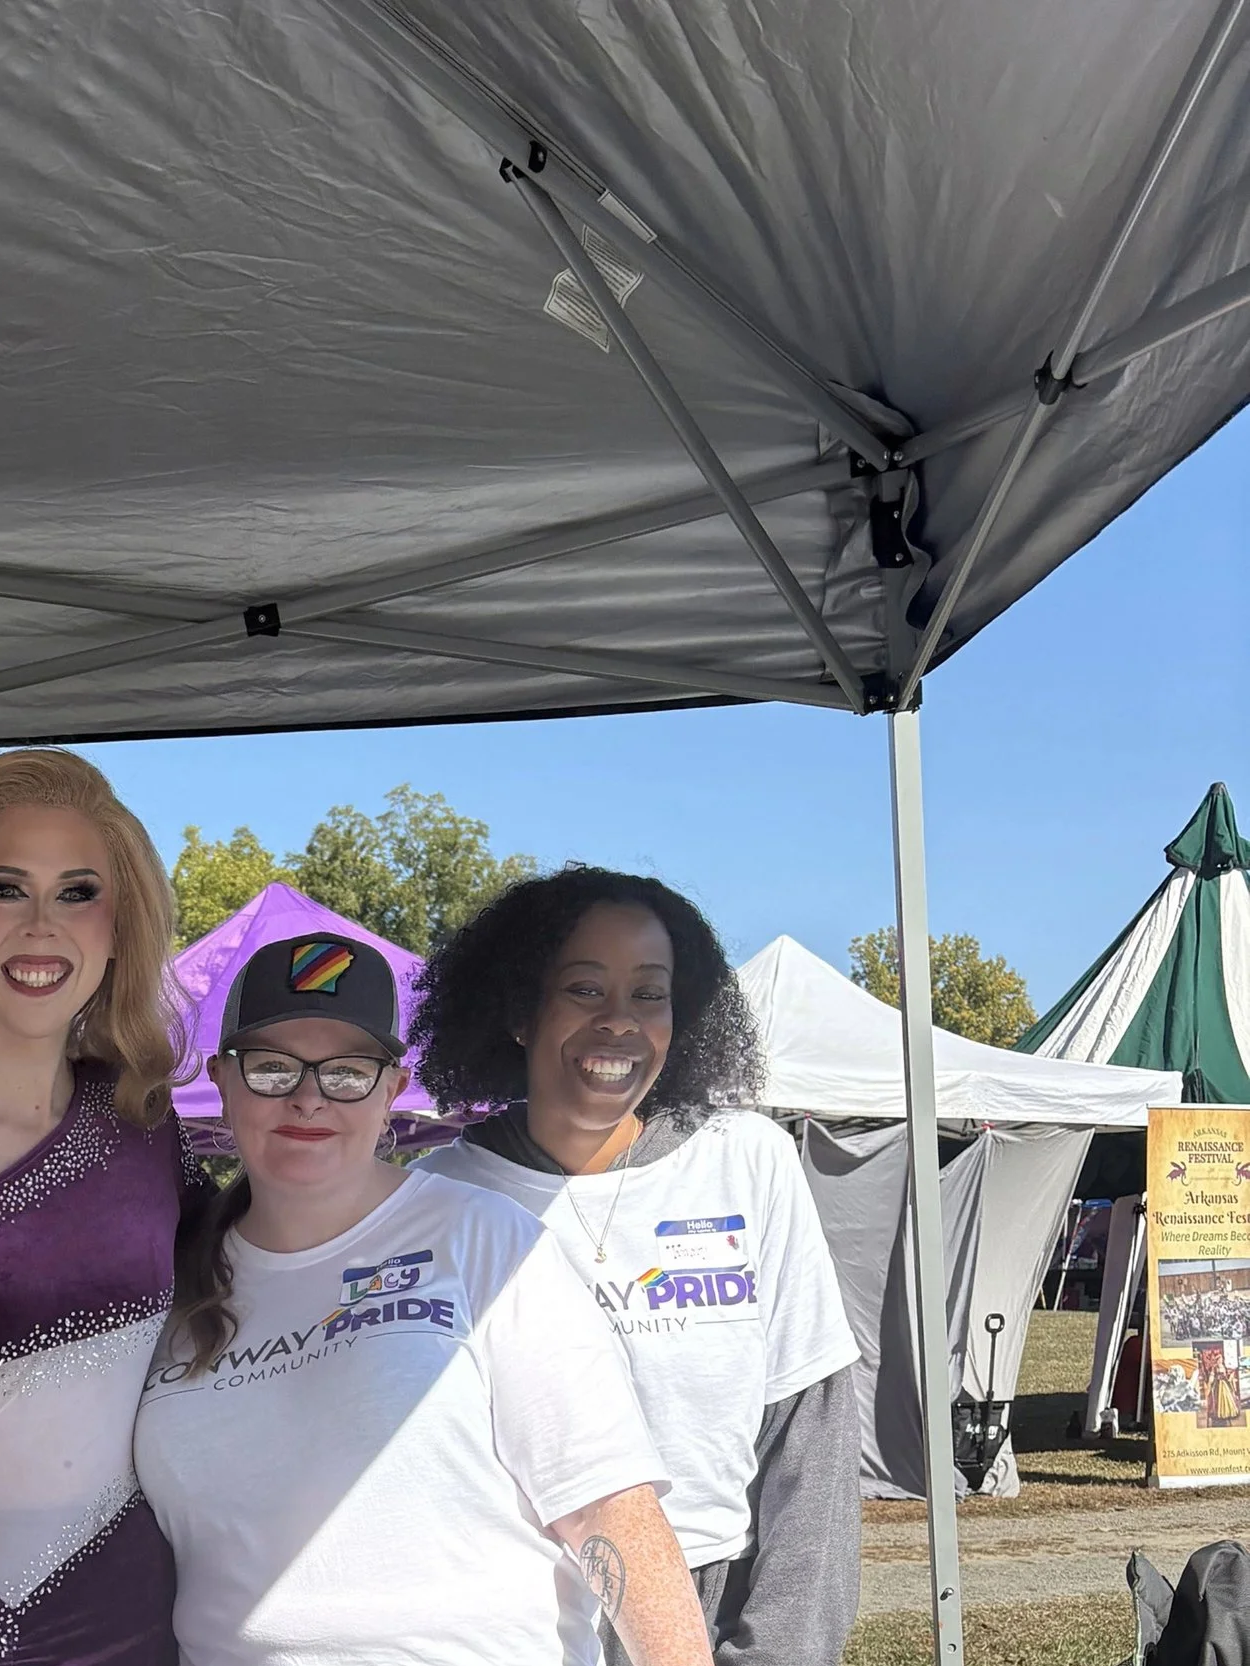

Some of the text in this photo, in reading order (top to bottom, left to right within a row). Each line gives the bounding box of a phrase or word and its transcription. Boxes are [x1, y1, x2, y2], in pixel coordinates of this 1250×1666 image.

[1193, 1127, 1228, 1139] ARKANSAS
[1178, 1141, 1244, 1153] RENAISSANCE
[1188, 1153, 1234, 1164] FESTIVAL
[1184, 1190, 1239, 1207] Arkansas
[686, 1220, 714, 1230] Hello
[1152, 1211, 1225, 1227] Renaissance
[1161, 1230, 1191, 1243] Where
[1192, 1230, 1228, 1243] Dreams
[1198, 1244, 1232, 1258] Reality
[323, 1298, 455, 1342] PRIDE
[213, 1335, 359, 1391] COMMUNITY
[1162, 1449, 1176, 1459] 275
[1177, 1448, 1209, 1458] Adkisson
[1209, 1447, 1222, 1457] Rd,
[1223, 1447, 1246, 1456] Mount
